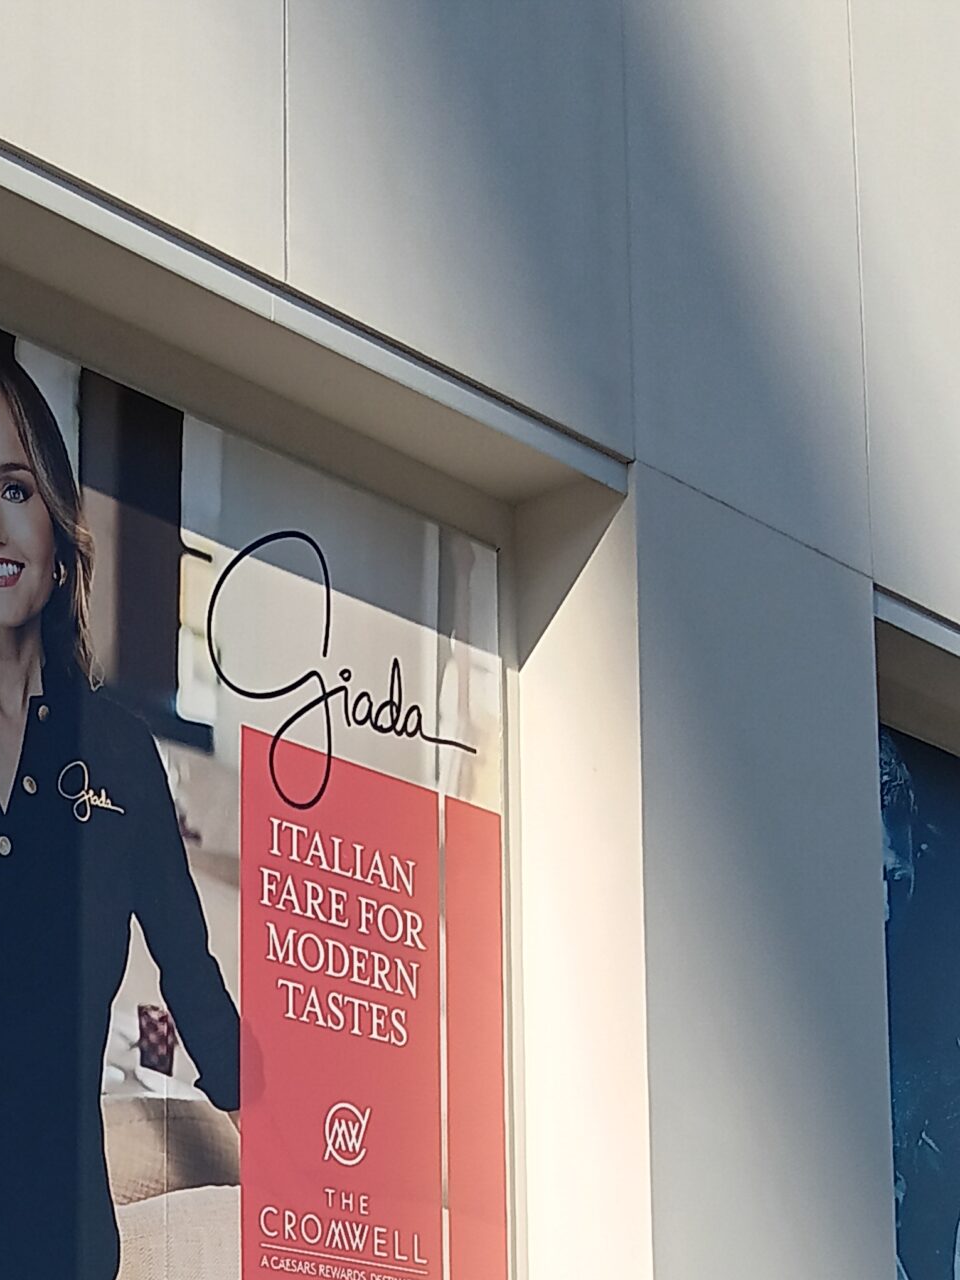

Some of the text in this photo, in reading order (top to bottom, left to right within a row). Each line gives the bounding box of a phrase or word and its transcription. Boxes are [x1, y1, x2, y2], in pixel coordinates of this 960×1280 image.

[206, 530, 477, 811] Giada
[268, 816, 416, 897] ITALIAN
[258, 866, 427, 951] FARE FOR
[265, 921, 420, 999] MODERN
[277, 978, 408, 1047] TASTES
[259, 1206, 428, 1264] CROMWELL
[324, 1187, 370, 1215] THE
[260, 1255, 270, 1268] A
[270, 1256, 317, 1275] CAESARS
